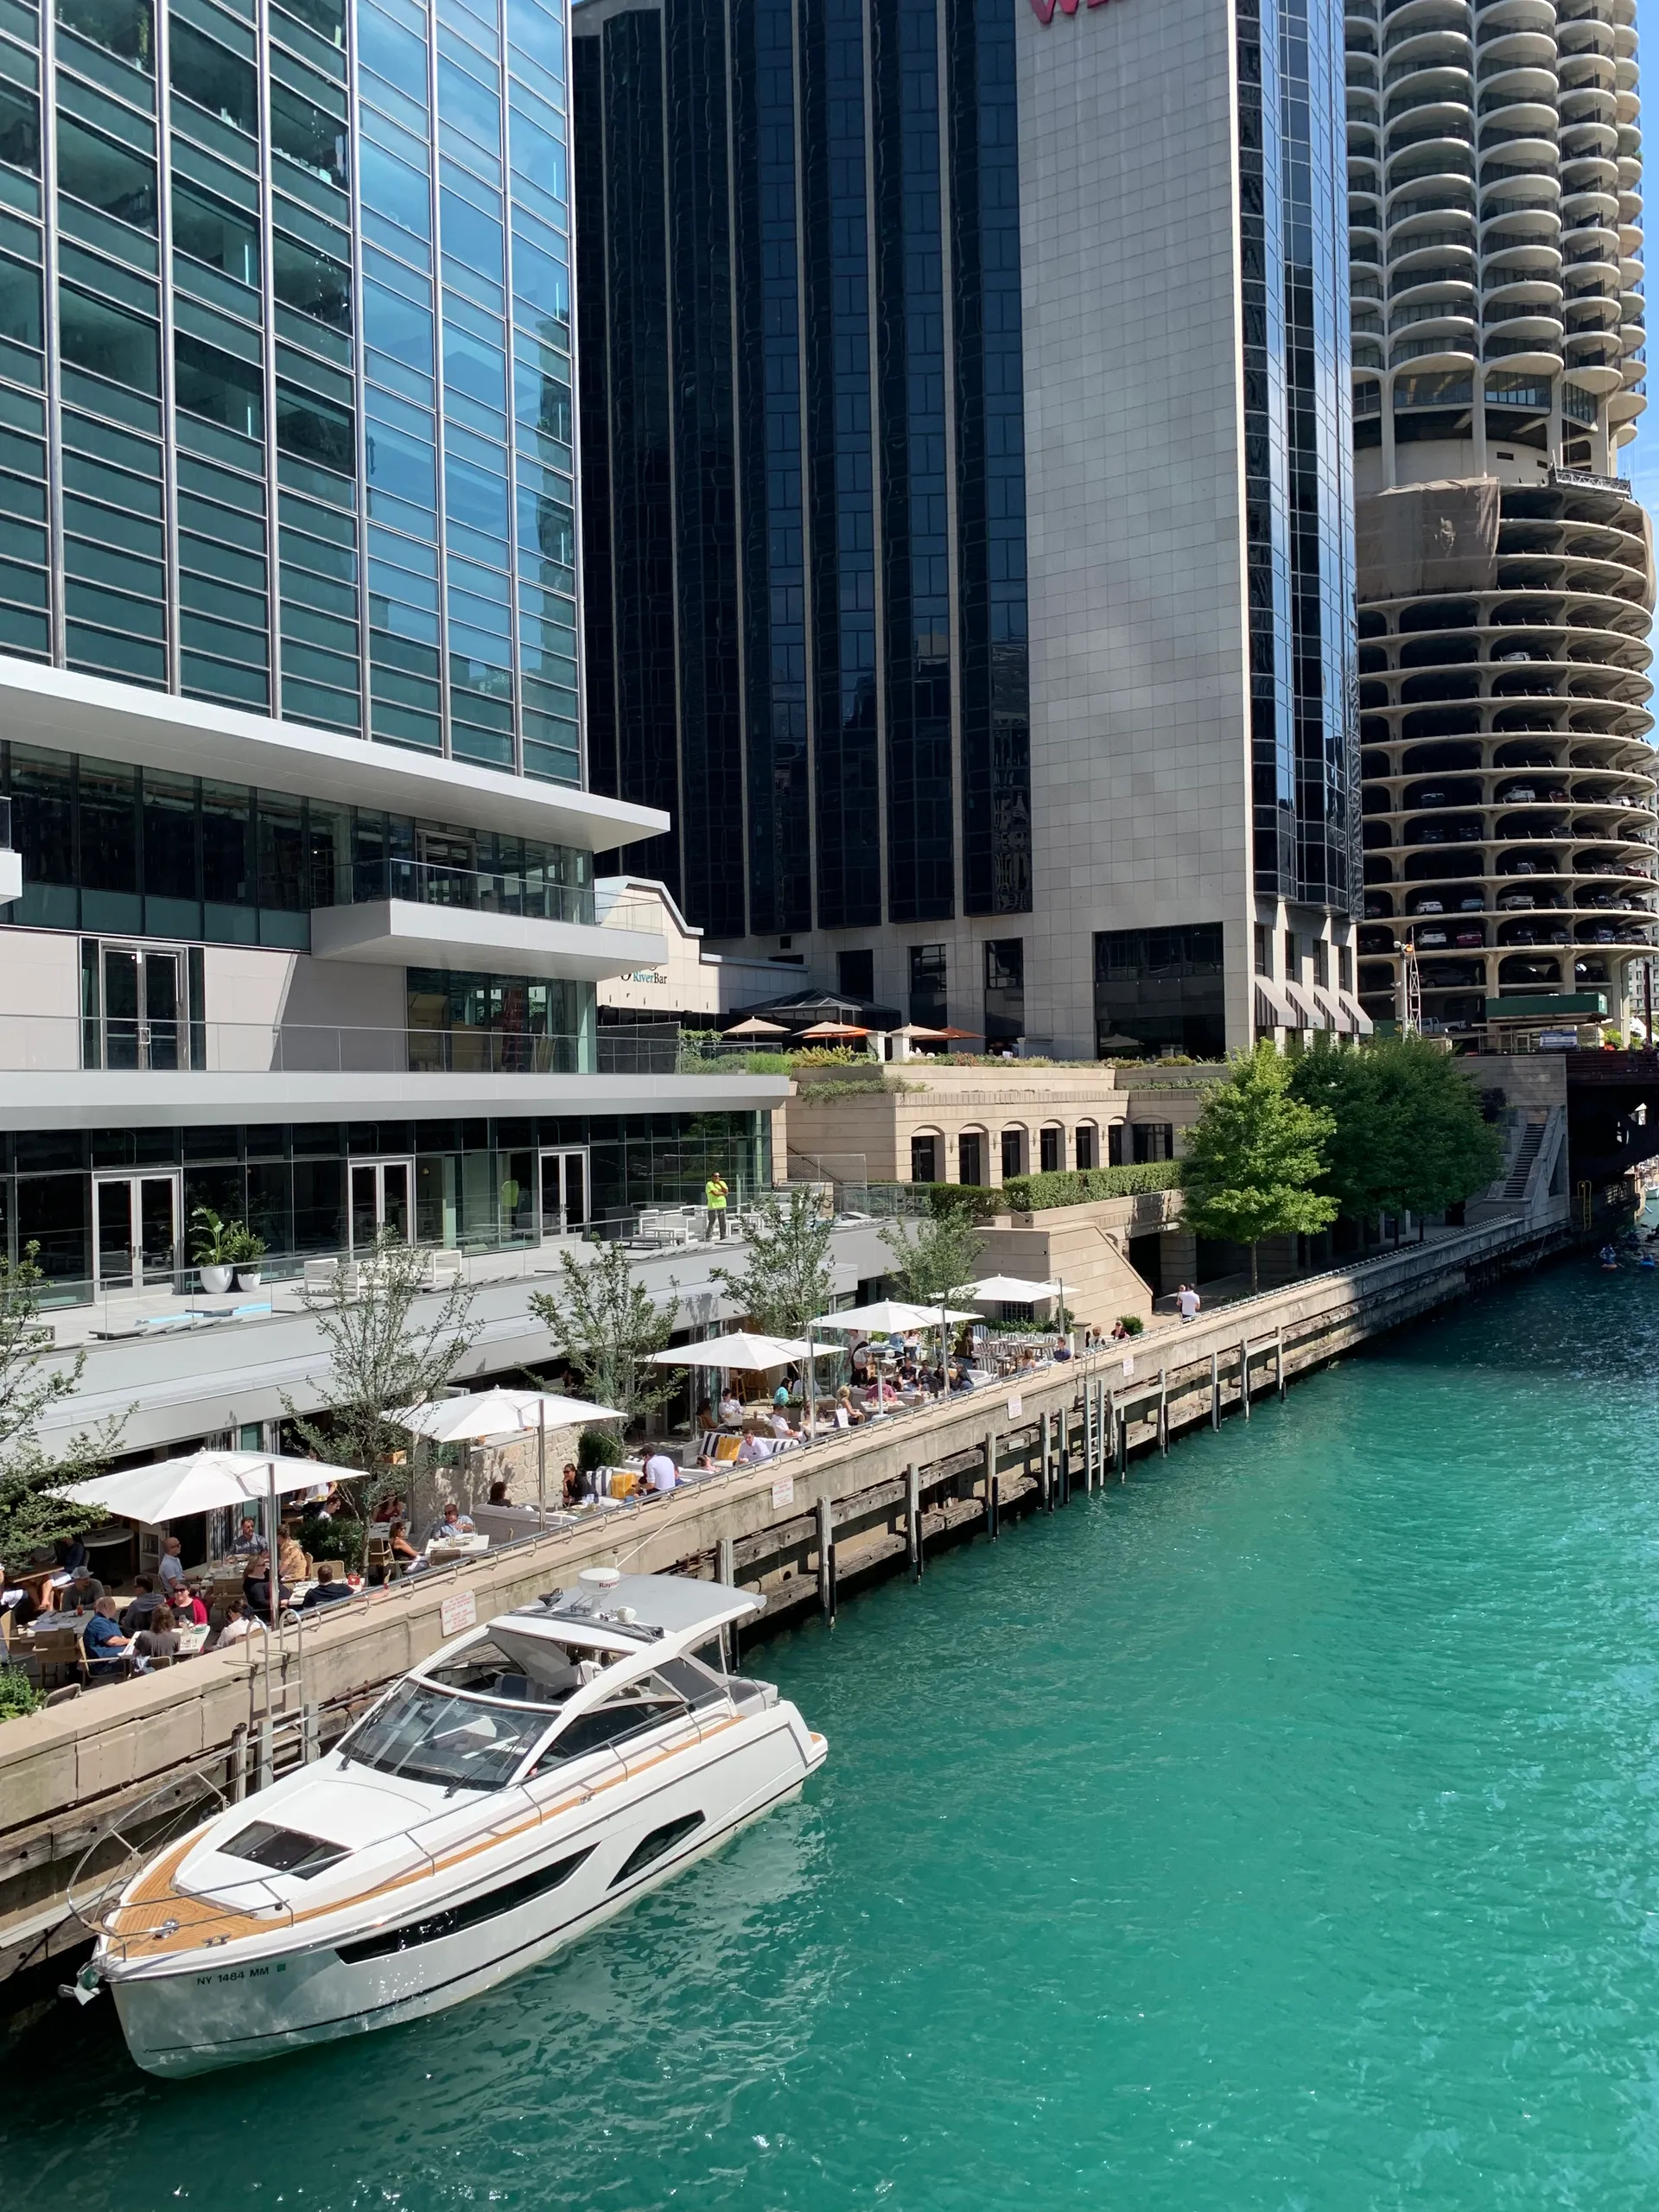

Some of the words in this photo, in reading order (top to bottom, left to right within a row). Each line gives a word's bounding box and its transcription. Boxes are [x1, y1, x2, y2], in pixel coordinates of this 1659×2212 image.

[633, 971, 667, 984] RiverBar
[197, 1976, 212, 1985] NY
[218, 1971, 245, 1982] 1484
[250, 1967, 269, 1977] MM
